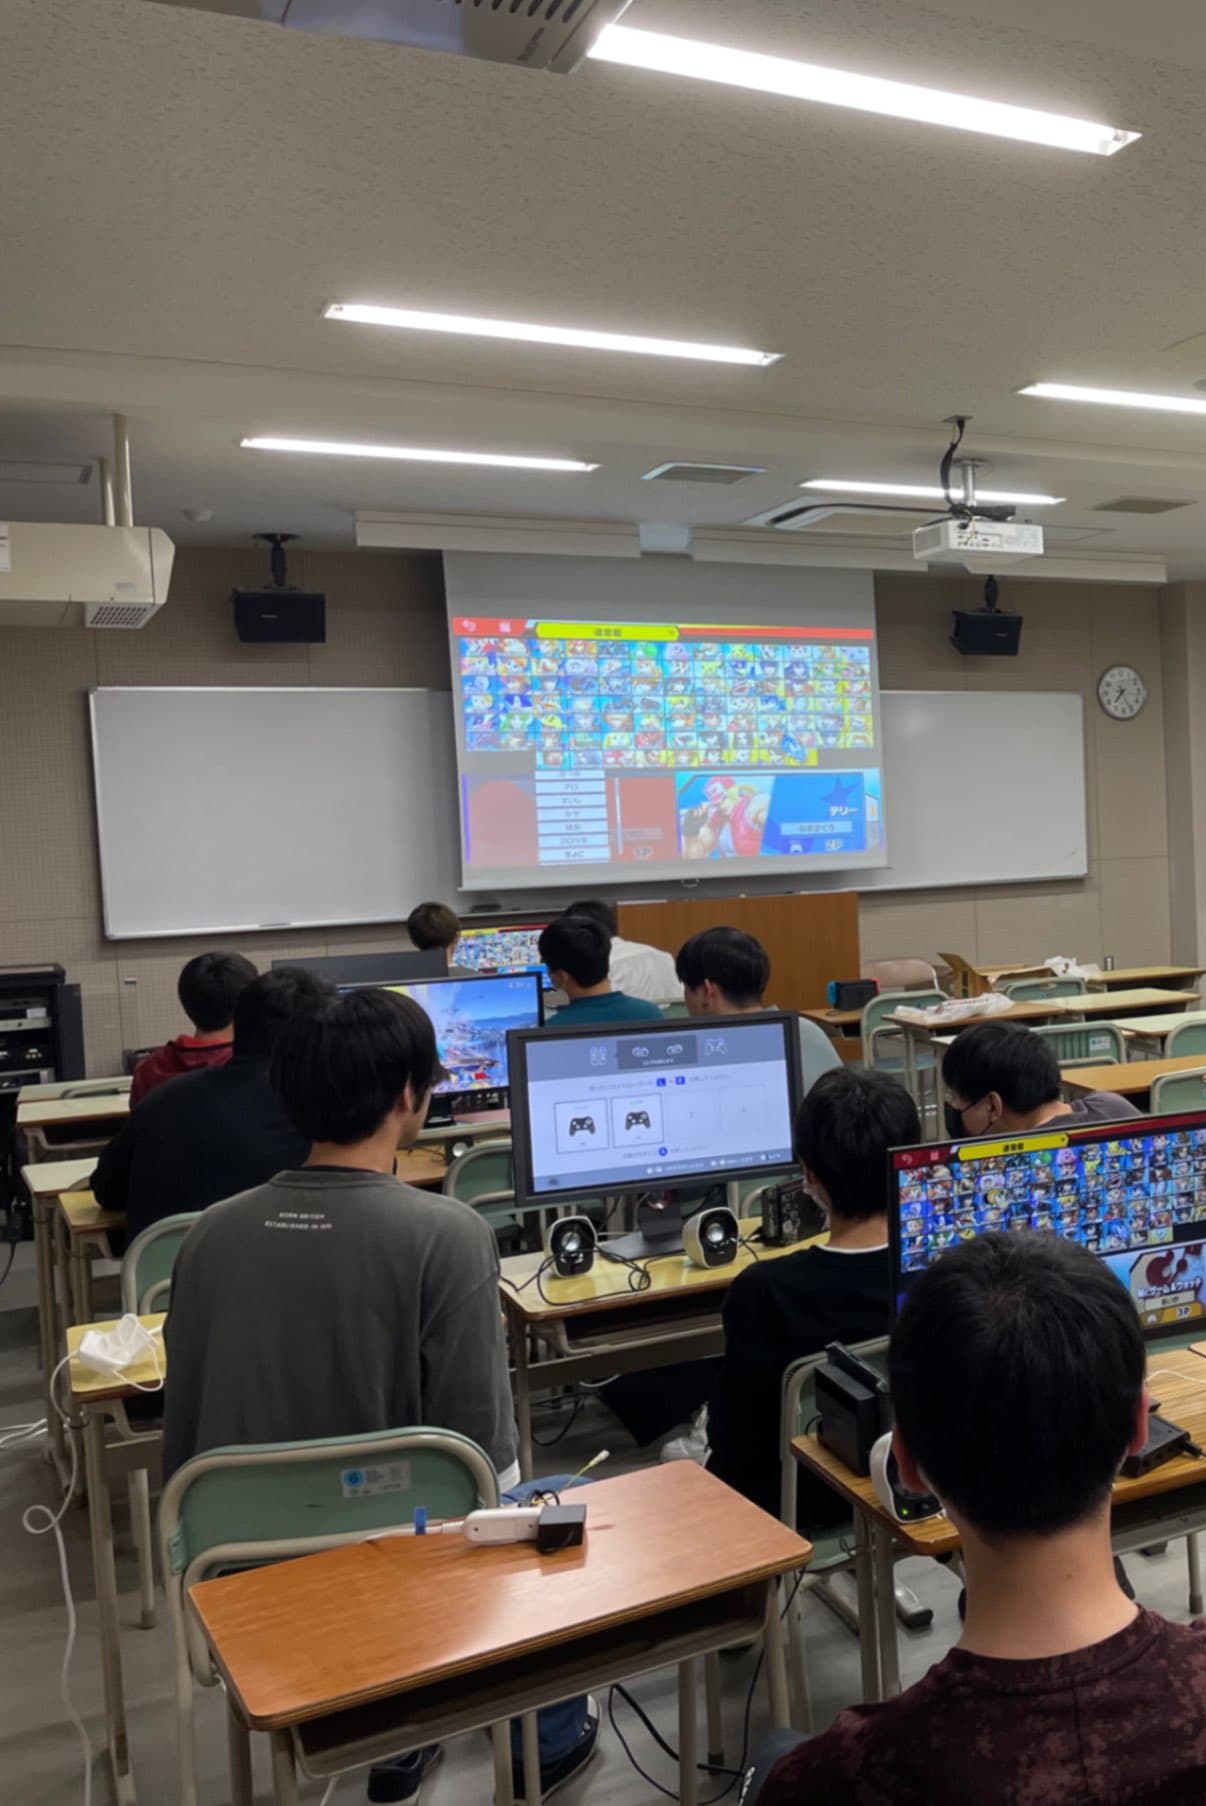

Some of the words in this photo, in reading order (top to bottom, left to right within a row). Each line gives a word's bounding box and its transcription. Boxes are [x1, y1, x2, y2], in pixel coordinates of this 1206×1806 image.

[829, 805, 858, 817] テリー
[1177, 1307, 1191, 1318] 3P
